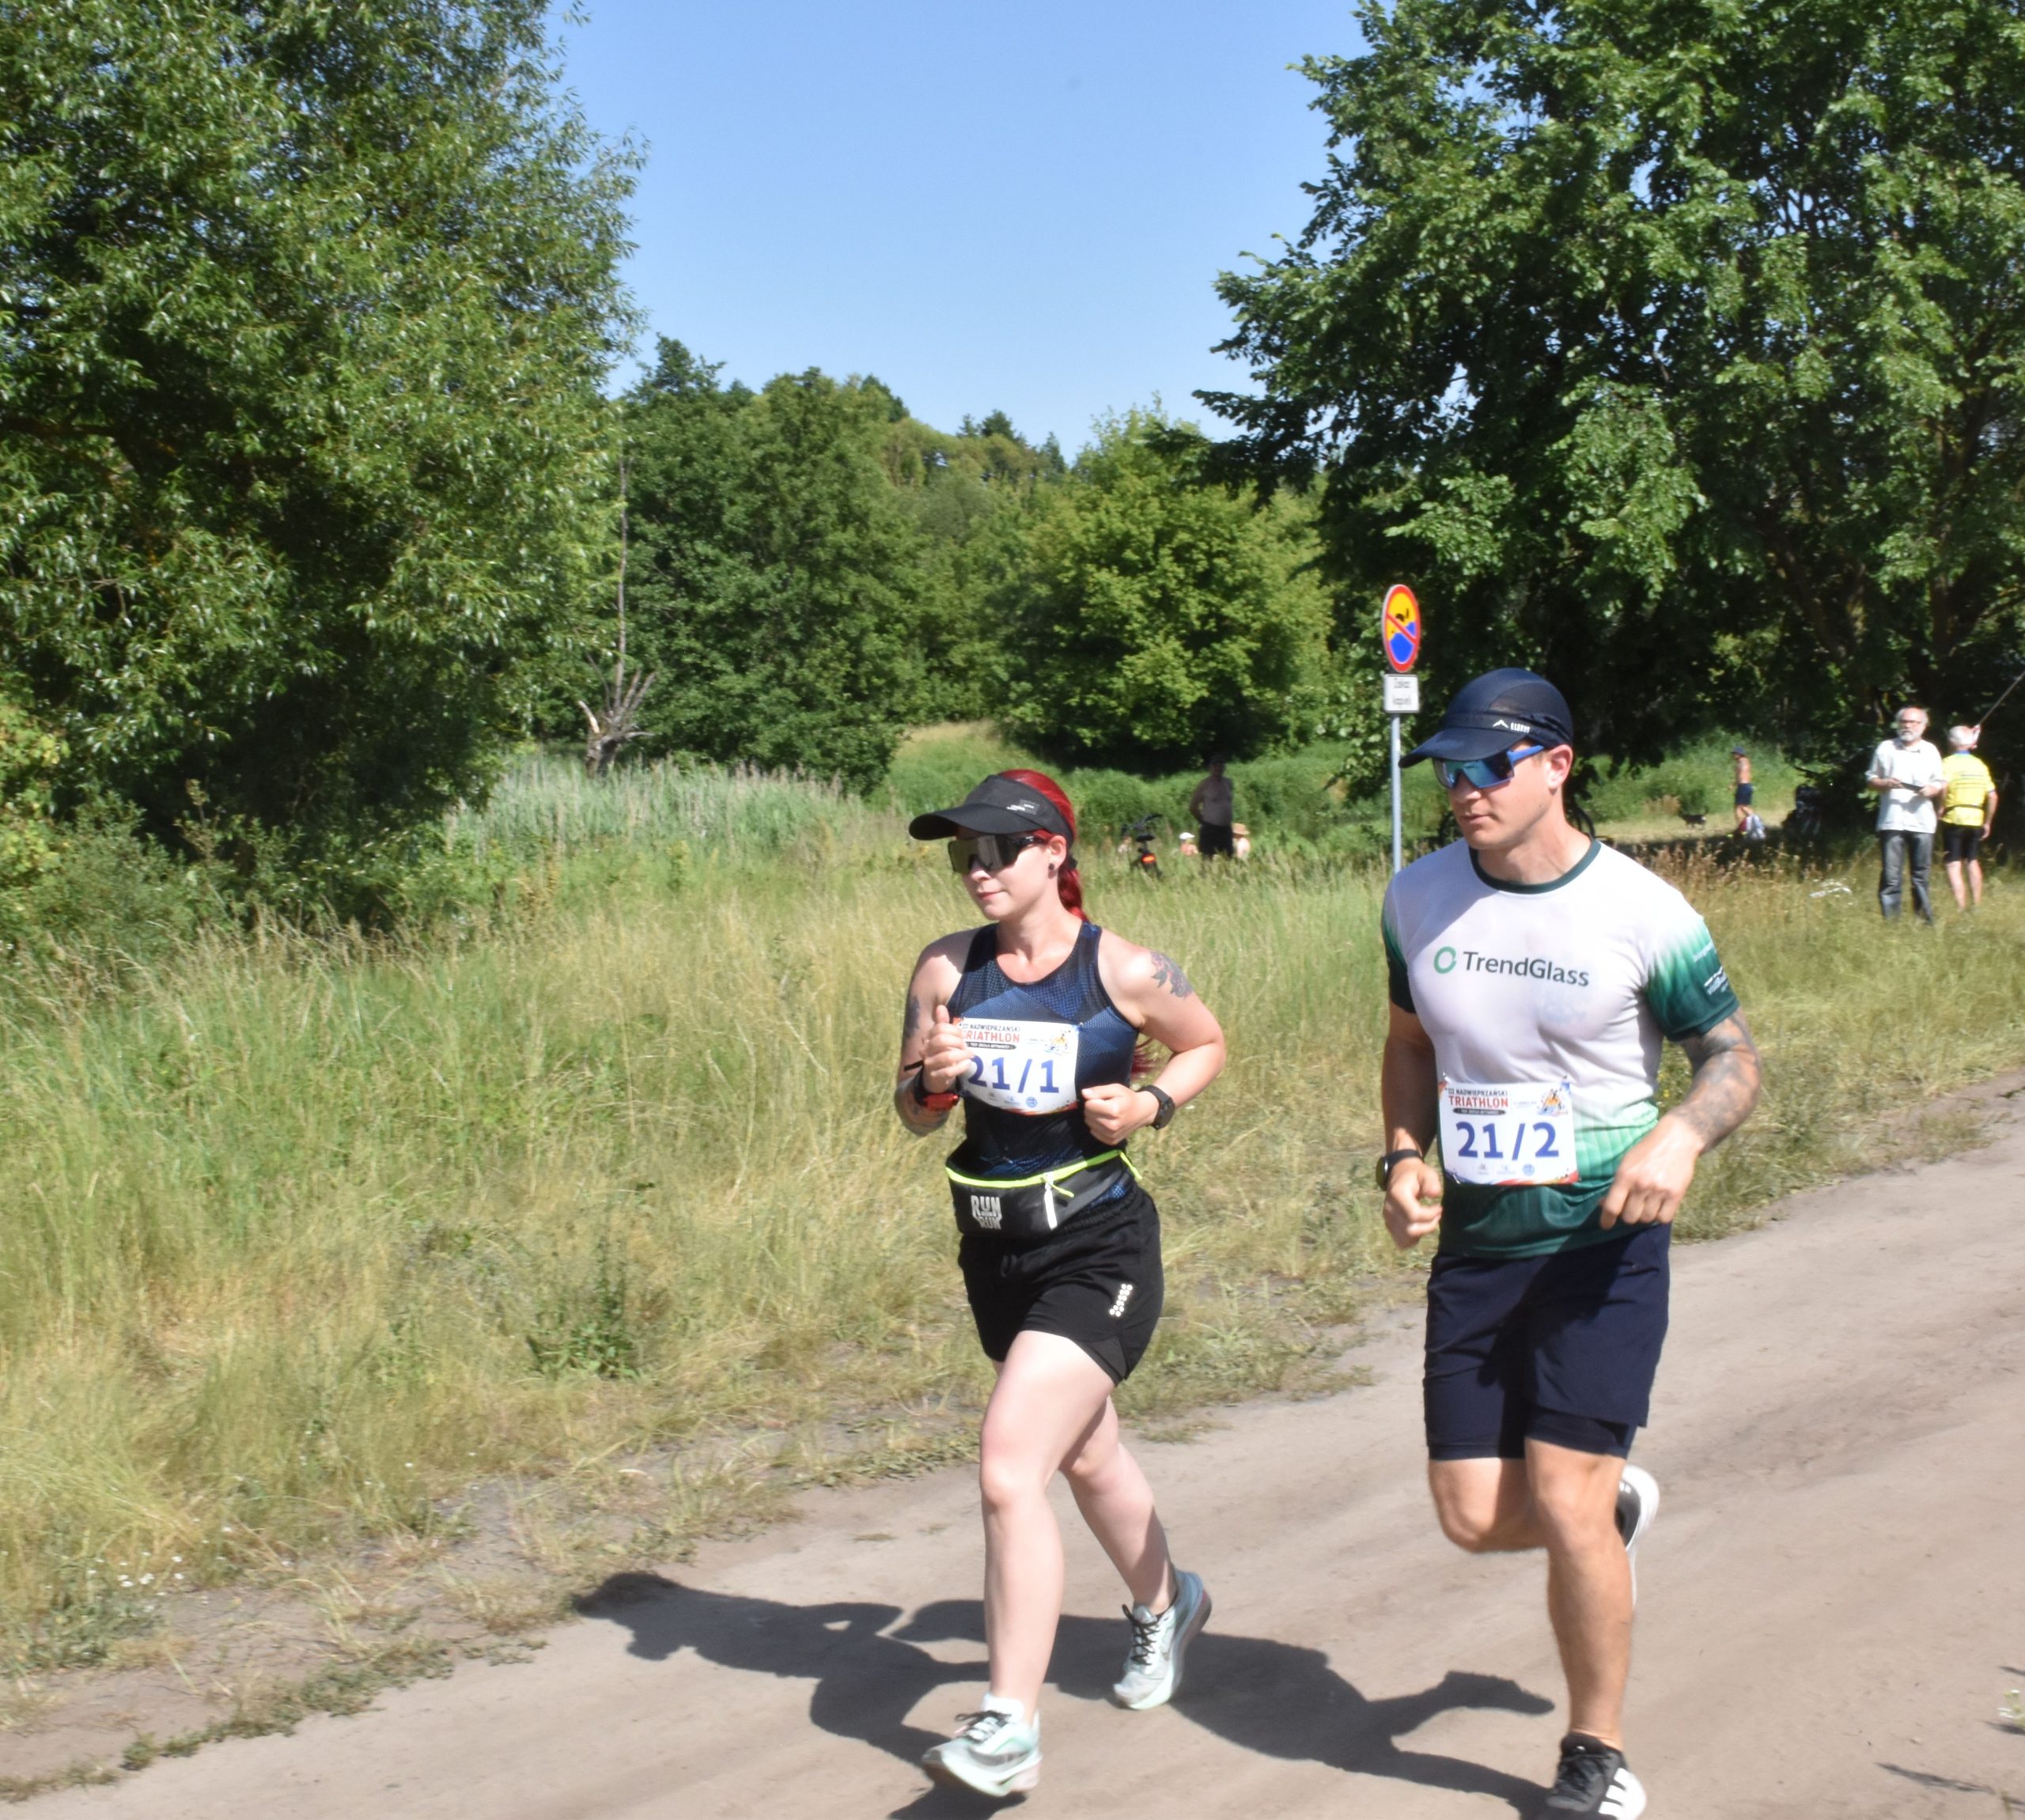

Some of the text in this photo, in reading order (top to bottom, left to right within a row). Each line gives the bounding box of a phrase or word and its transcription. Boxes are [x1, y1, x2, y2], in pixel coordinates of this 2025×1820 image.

[1463, 951, 1589, 987] TrendGlass
[967, 1054, 1059, 1094] 21/1
[1448, 1095, 1508, 1107] TRIATHLON
[1455, 1121, 1559, 1161] 21/2
[971, 1195, 1002, 1219] RUN
